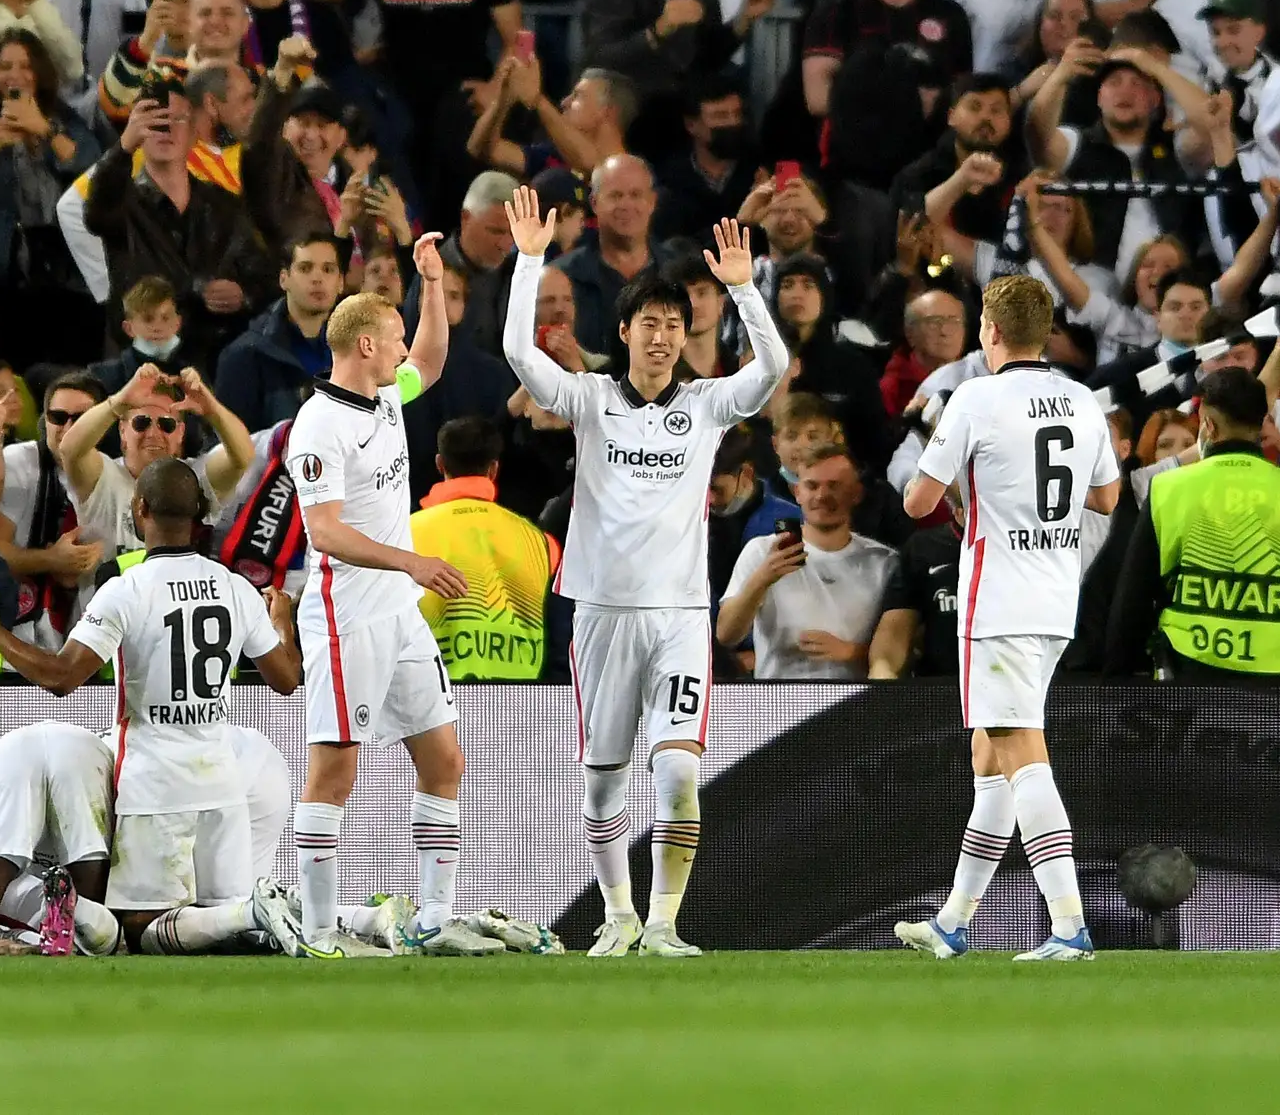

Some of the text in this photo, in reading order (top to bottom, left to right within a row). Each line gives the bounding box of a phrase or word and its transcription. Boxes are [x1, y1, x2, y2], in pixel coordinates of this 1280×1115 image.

[605, 441, 687, 468] indeed
[1034, 424, 1075, 523] 6
[631, 469, 653, 480] Jobs
[250, 475, 294, 556] KFURT
[166, 575, 221, 603] TOURÉ
[164, 604, 233, 703] 18
[436, 629, 542, 667] ECURITY
[1189, 623, 1257, 661] 061
[668, 674, 702, 716] 15
